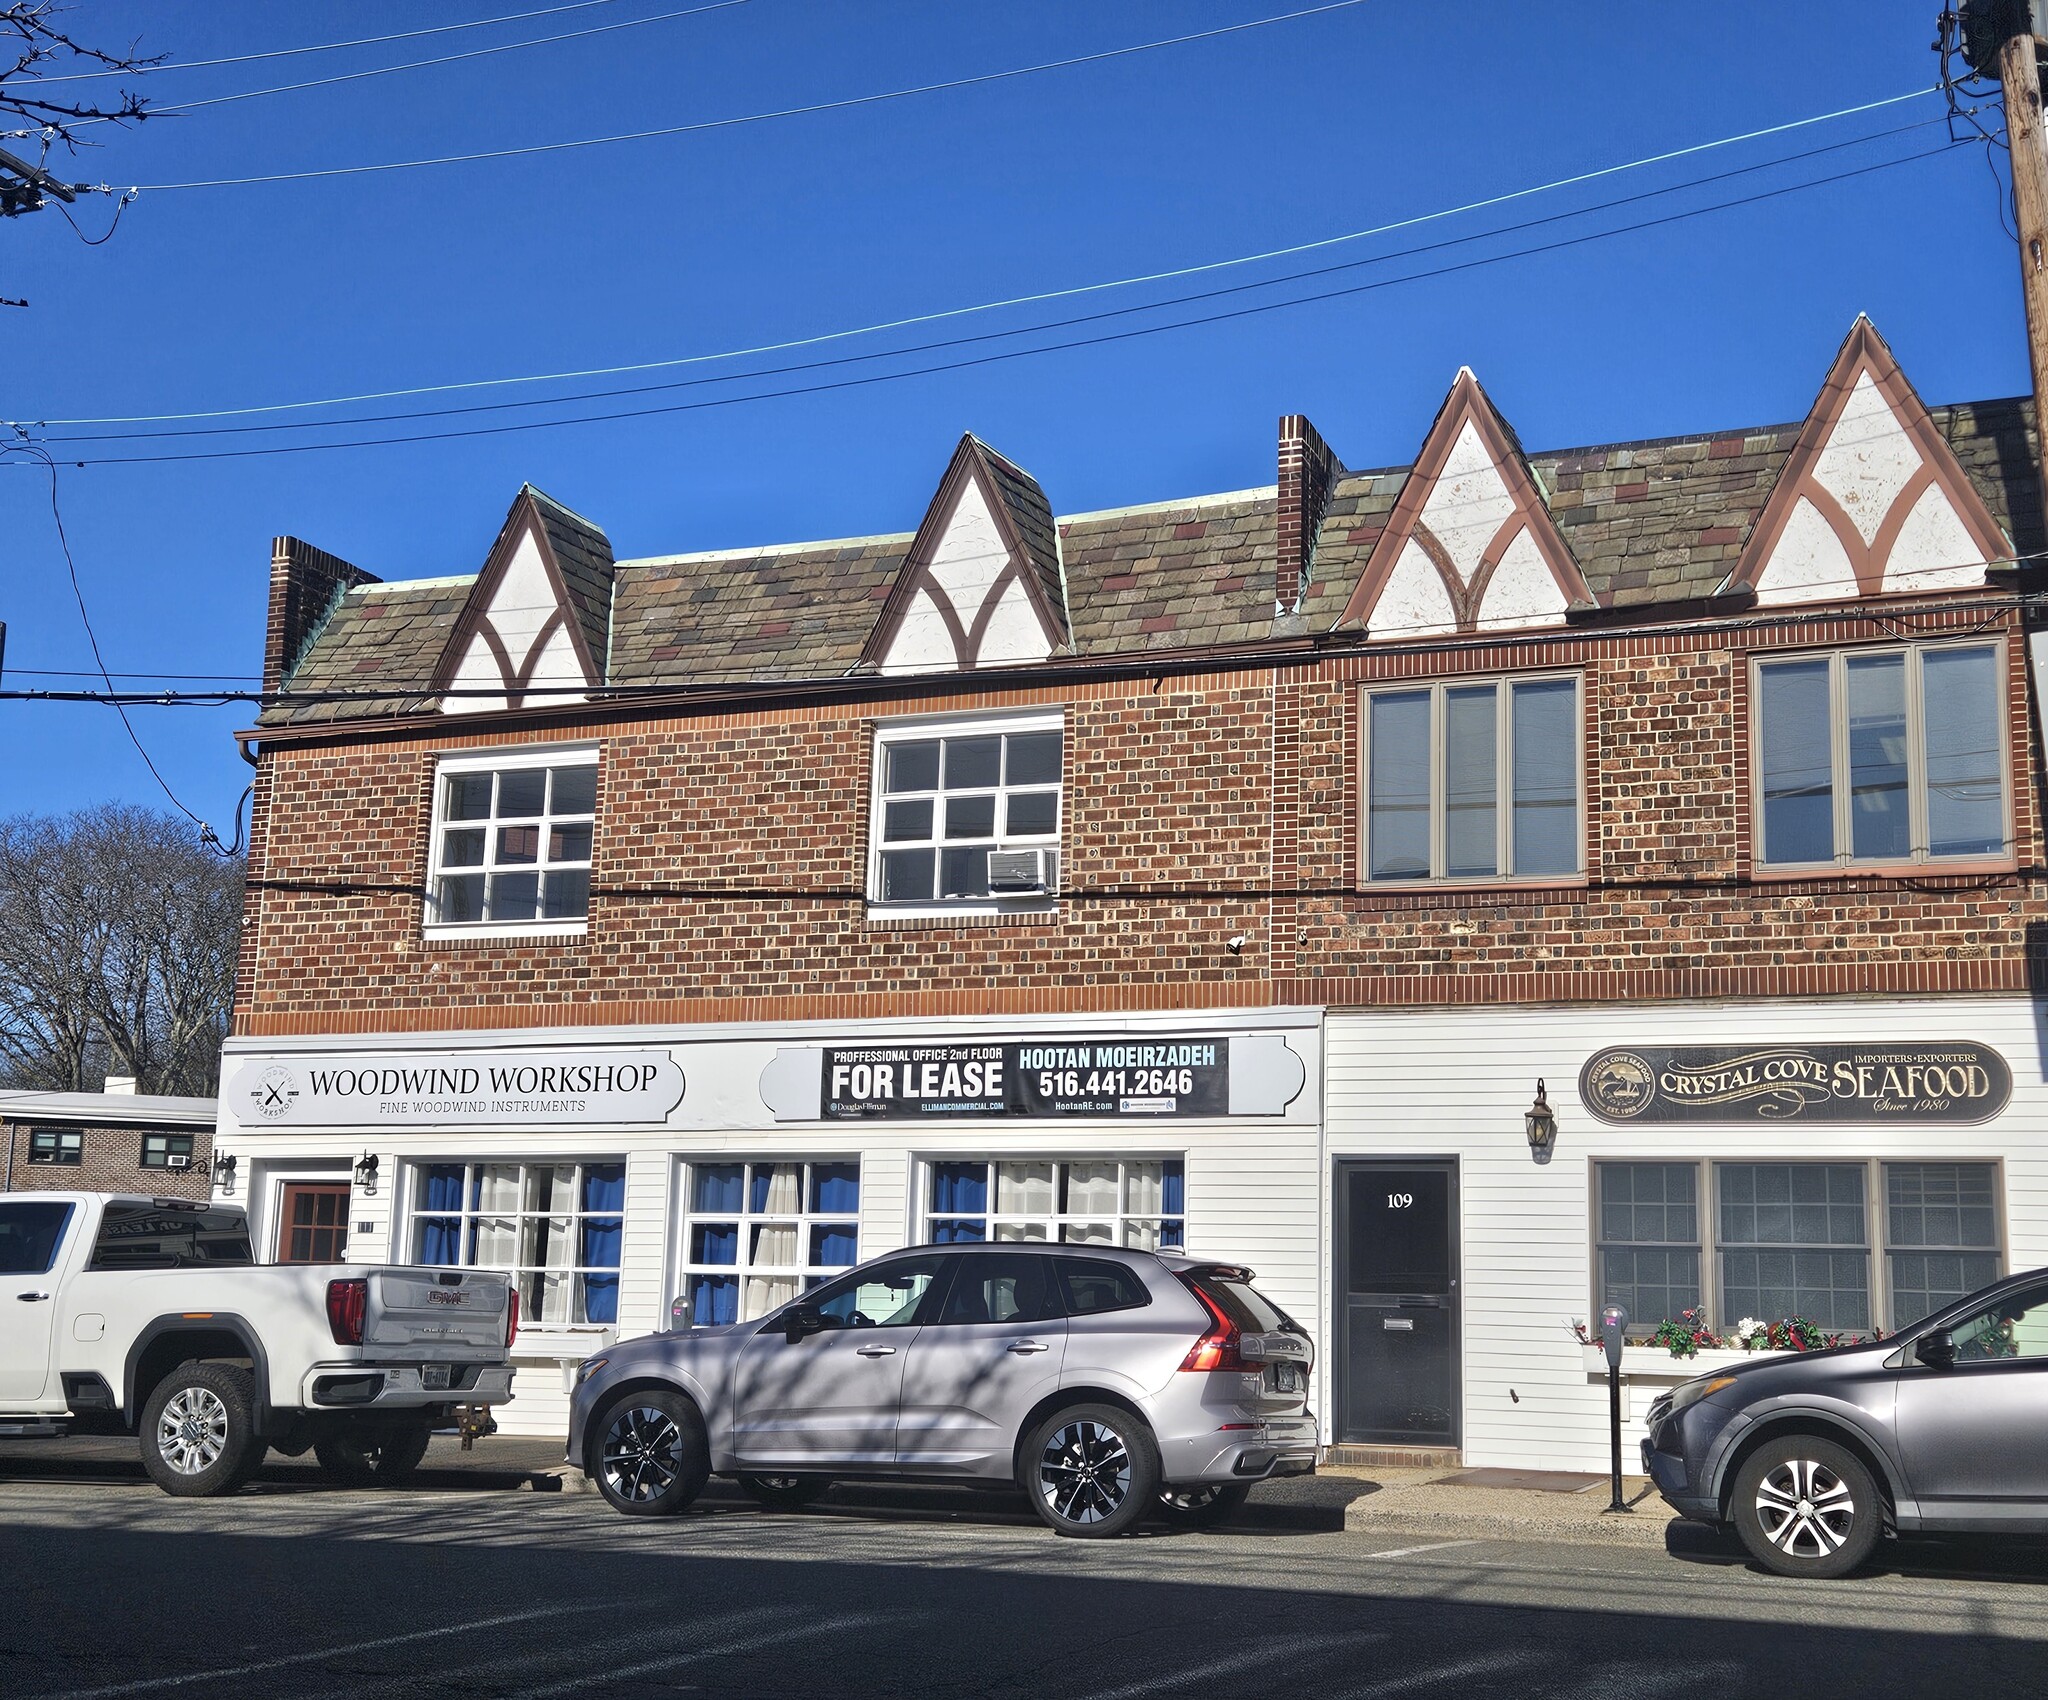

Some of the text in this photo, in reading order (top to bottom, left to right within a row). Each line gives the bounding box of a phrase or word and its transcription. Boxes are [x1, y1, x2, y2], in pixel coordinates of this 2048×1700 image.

[834, 1048, 1003, 1063] PROFFESSIONAL OFFICE 2nd FLOOR
[1019, 1045, 1215, 1070] HOOTAN MOEIRZADEH
[309, 1064, 657, 1096] WOODWIND WORKSHOP
[832, 1062, 1003, 1100] FOR LEASE
[1039, 1069, 1193, 1097] 516.441.2646
[1660, 1059, 1829, 1095] CRYSTAL COVE
[1832, 1060, 1989, 1098] SEAFOOD
[380, 1100, 586, 1113] FINE WOODWIND INSTRUMENTS
[921, 1102, 1004, 1111] ELLIMANCOMMERCIAL.COM
[1055, 1101, 1113, 1111] HootanRE.com
[1873, 1097, 1950, 1113] Since 1980
[1387, 1193, 1413, 1208] 109
[427, 1291, 471, 1305] GMC
